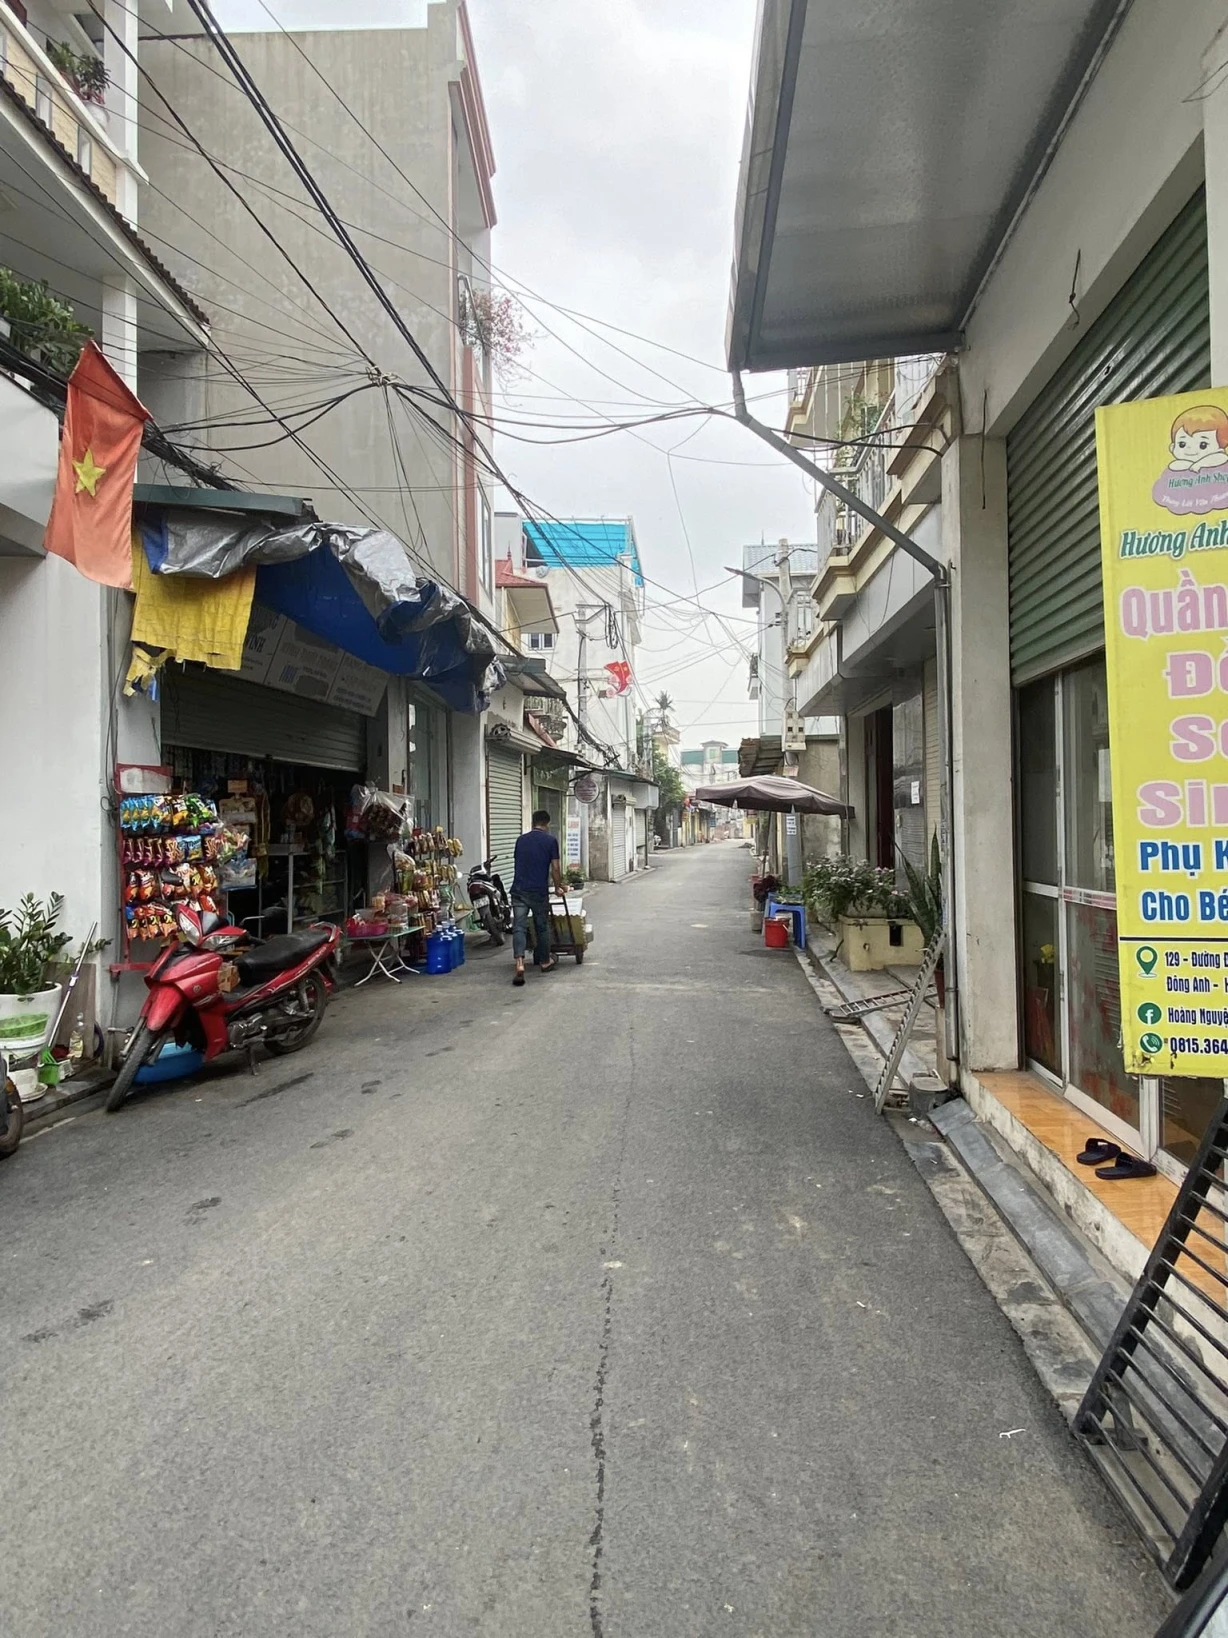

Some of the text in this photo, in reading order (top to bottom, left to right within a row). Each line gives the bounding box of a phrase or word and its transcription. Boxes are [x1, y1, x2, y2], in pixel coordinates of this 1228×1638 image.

[1120, 519, 1228, 558] Hương Anh
[1121, 569, 1228, 638] Quần
[1165, 648, 1228, 697] Đ
[1170, 715, 1228, 761] S
[1139, 840, 1202, 877] Phụ
[1141, 888, 1228, 921] Cho Bé
[1164, 951, 1180, 967] 129
[1191, 950, 1221, 969] Đường
[1166, 974, 1190, 993] Đông
[1192, 976, 1211, 993] Anh
[1167, 1006, 1197, 1025] Hoàng
